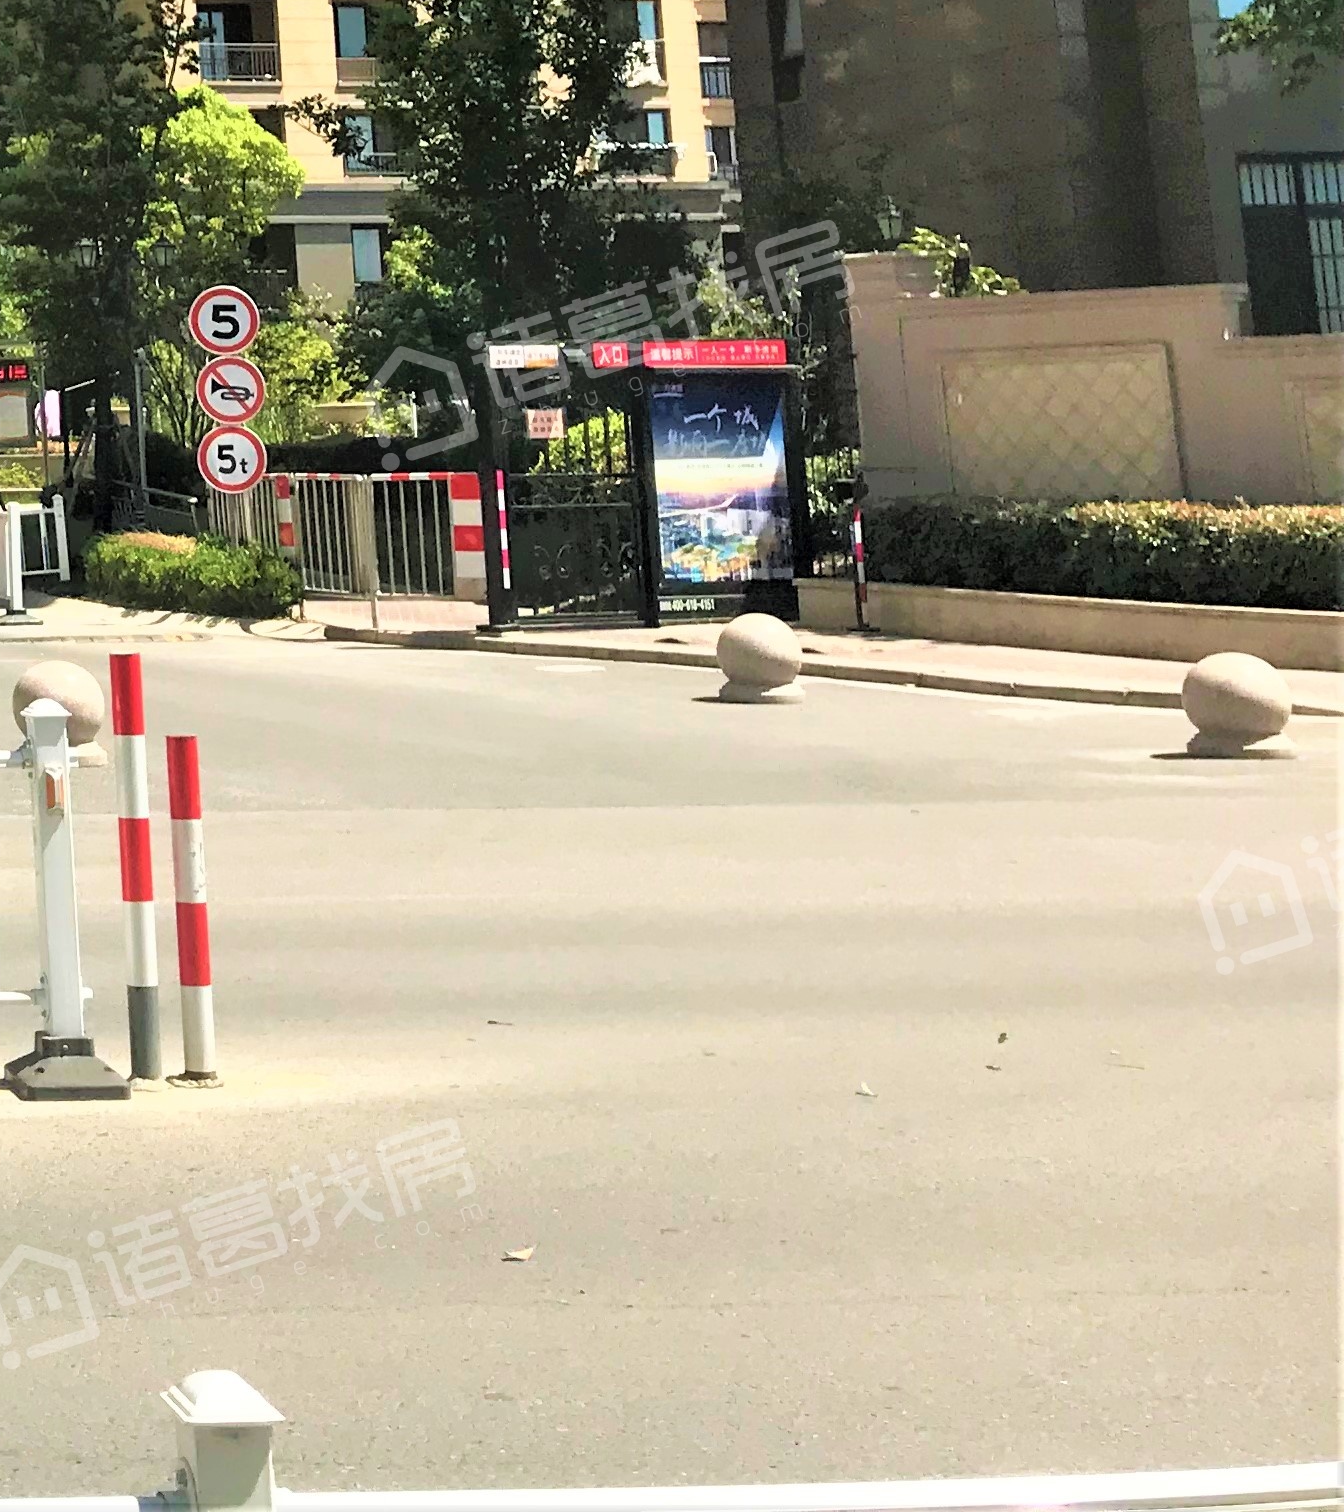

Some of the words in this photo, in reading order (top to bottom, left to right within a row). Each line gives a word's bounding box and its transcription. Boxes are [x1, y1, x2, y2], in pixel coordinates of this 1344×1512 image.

[211, 304, 240, 340] 5
[597, 346, 624, 365] 入口
[217, 444, 249, 475] 5t
